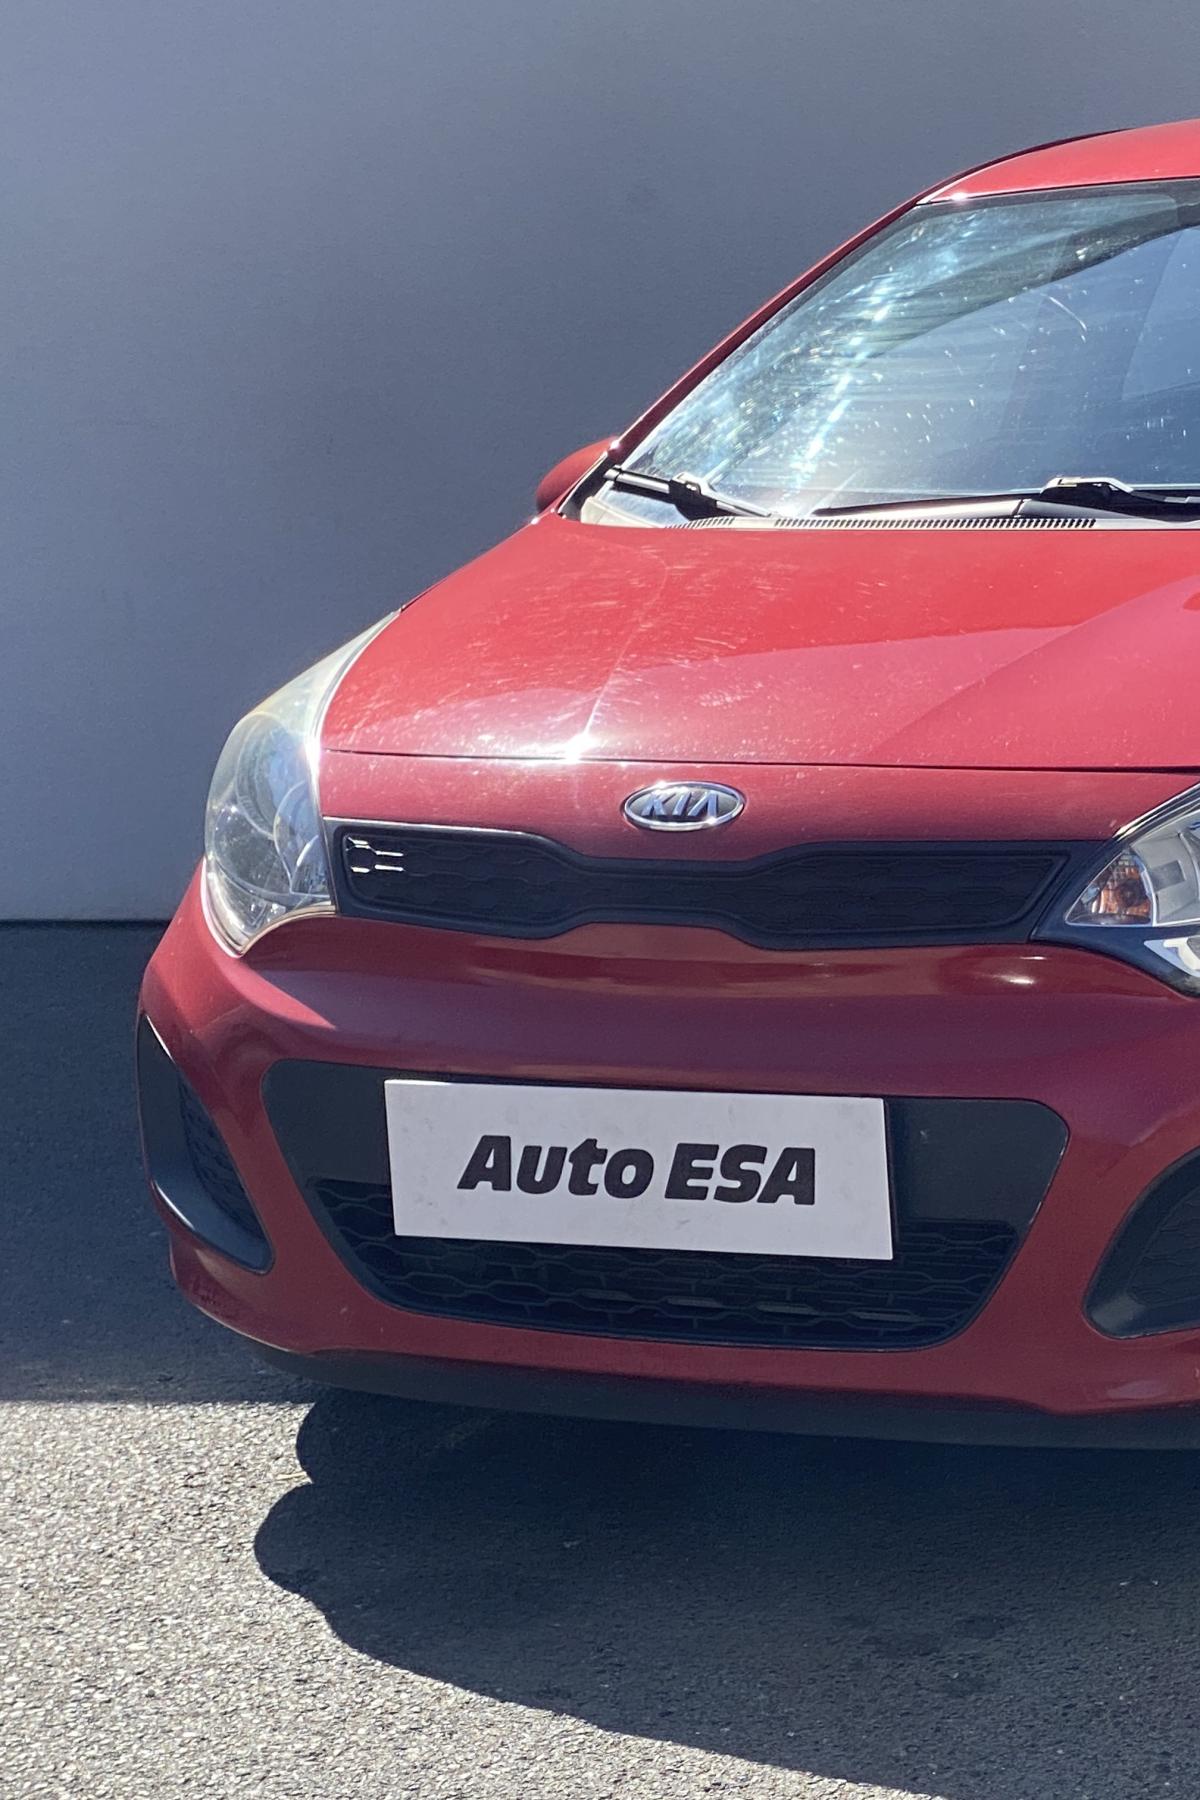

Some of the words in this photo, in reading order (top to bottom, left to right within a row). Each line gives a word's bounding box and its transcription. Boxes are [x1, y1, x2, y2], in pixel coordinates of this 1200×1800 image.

[640, 789, 718, 817] KIA
[457, 1135, 654, 1199] Auto
[664, 1143, 816, 1205] ESA
